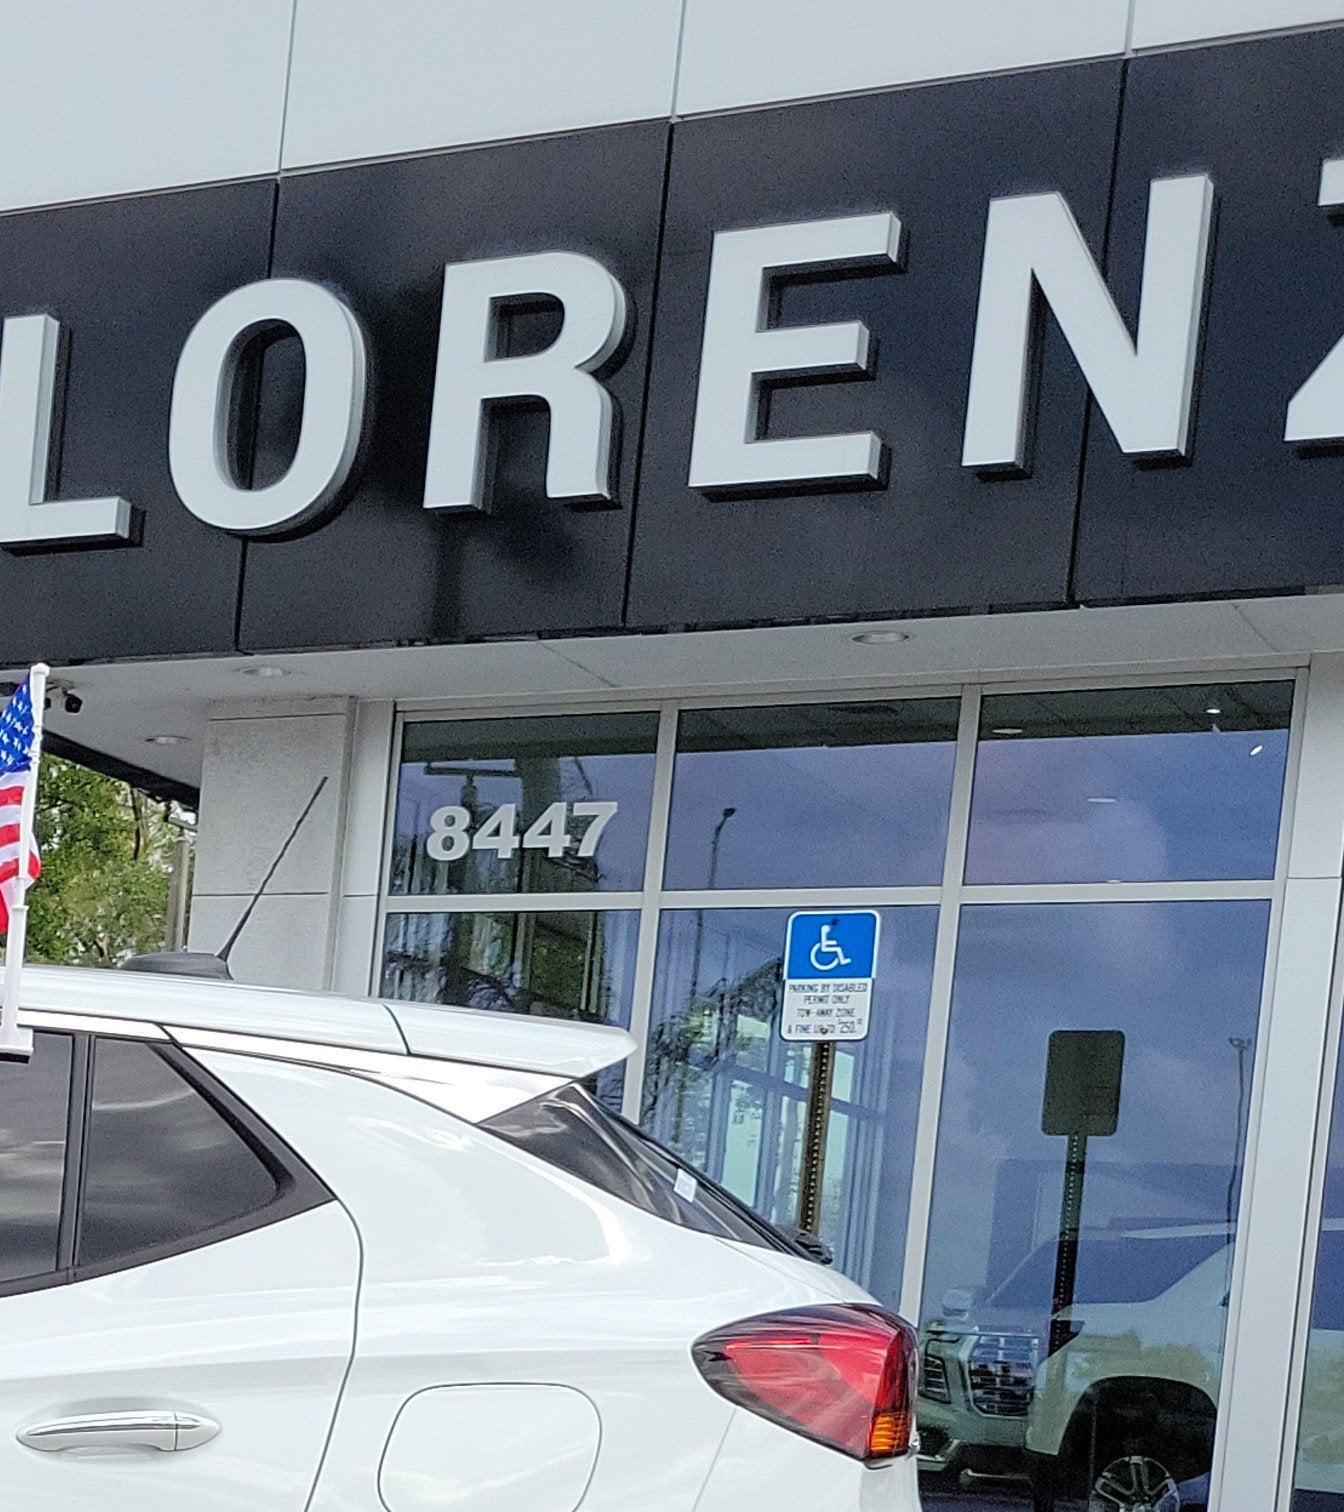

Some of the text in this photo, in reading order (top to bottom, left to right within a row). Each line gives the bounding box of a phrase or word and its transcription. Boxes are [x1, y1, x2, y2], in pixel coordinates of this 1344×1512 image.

[426, 801, 618, 861] 8447
[788, 983, 819, 993] PARKING
[832, 982, 868, 992] DISABLED
